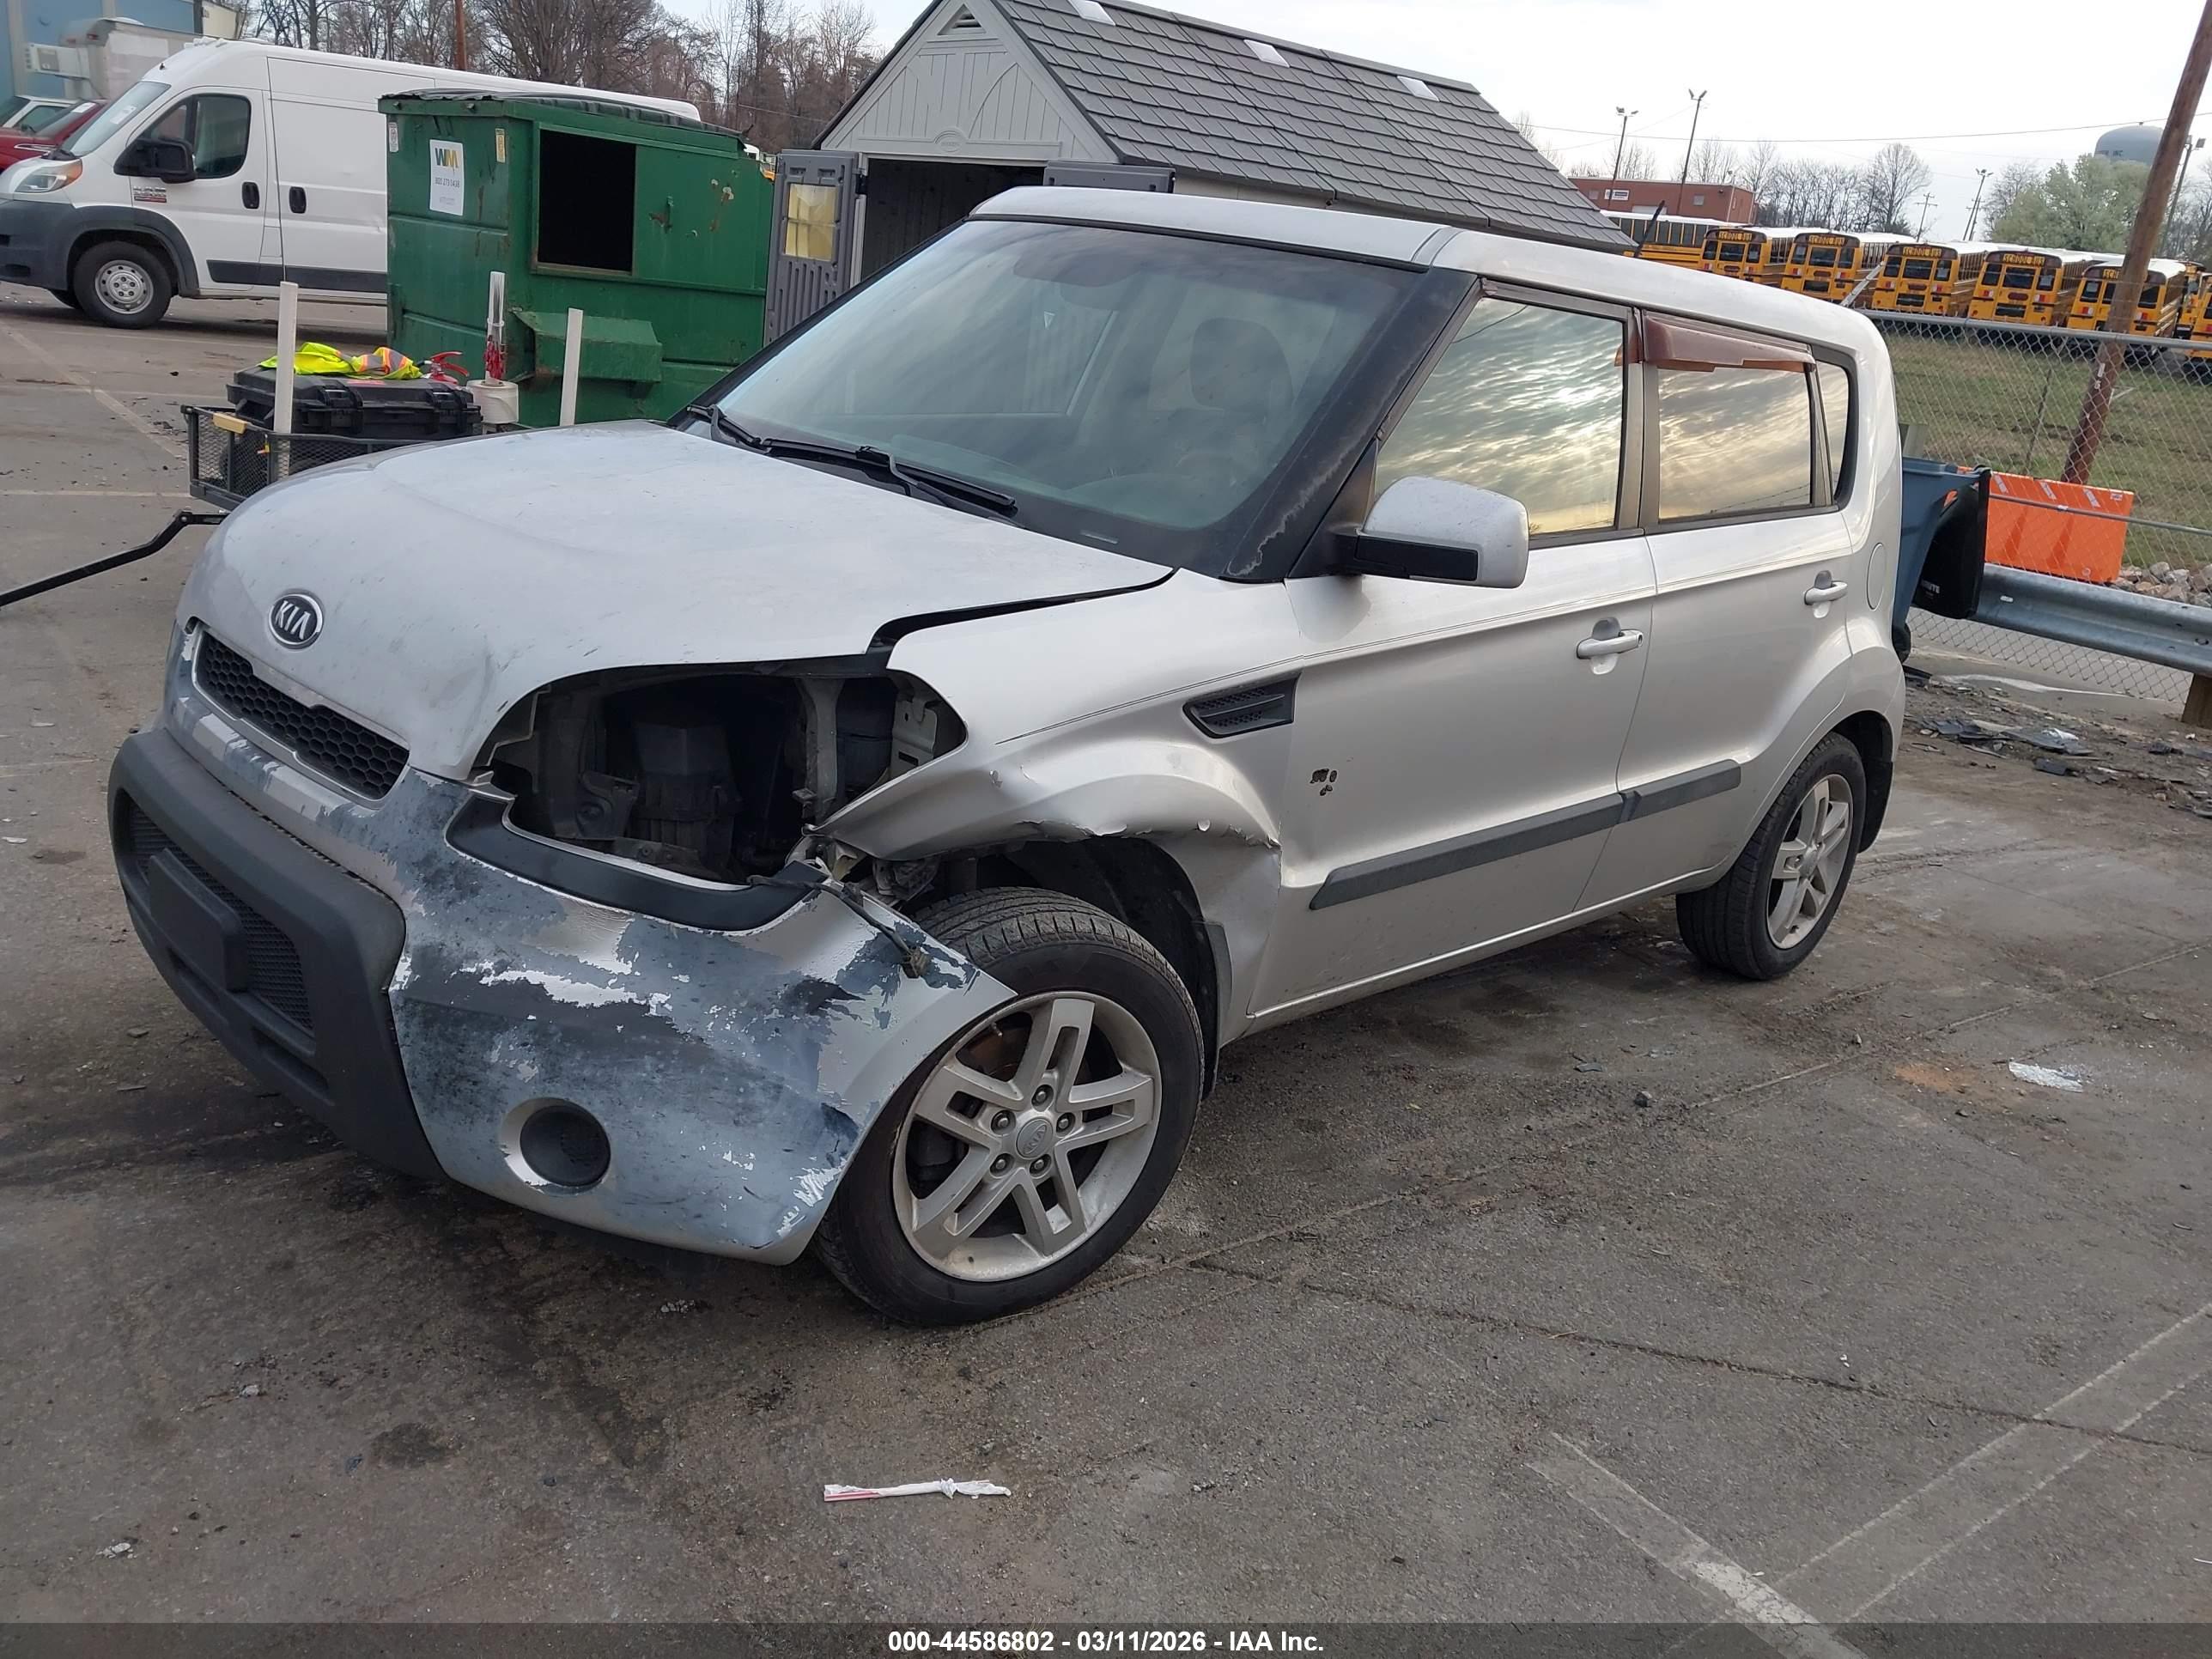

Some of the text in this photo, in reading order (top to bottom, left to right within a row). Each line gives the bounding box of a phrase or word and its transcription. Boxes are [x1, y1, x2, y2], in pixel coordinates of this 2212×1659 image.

[434, 148, 459, 168] WM
[1903, 246, 1926, 256] SCHOOL
[2003, 254, 2028, 264] SCHOOL
[275, 600, 311, 640] KIA
